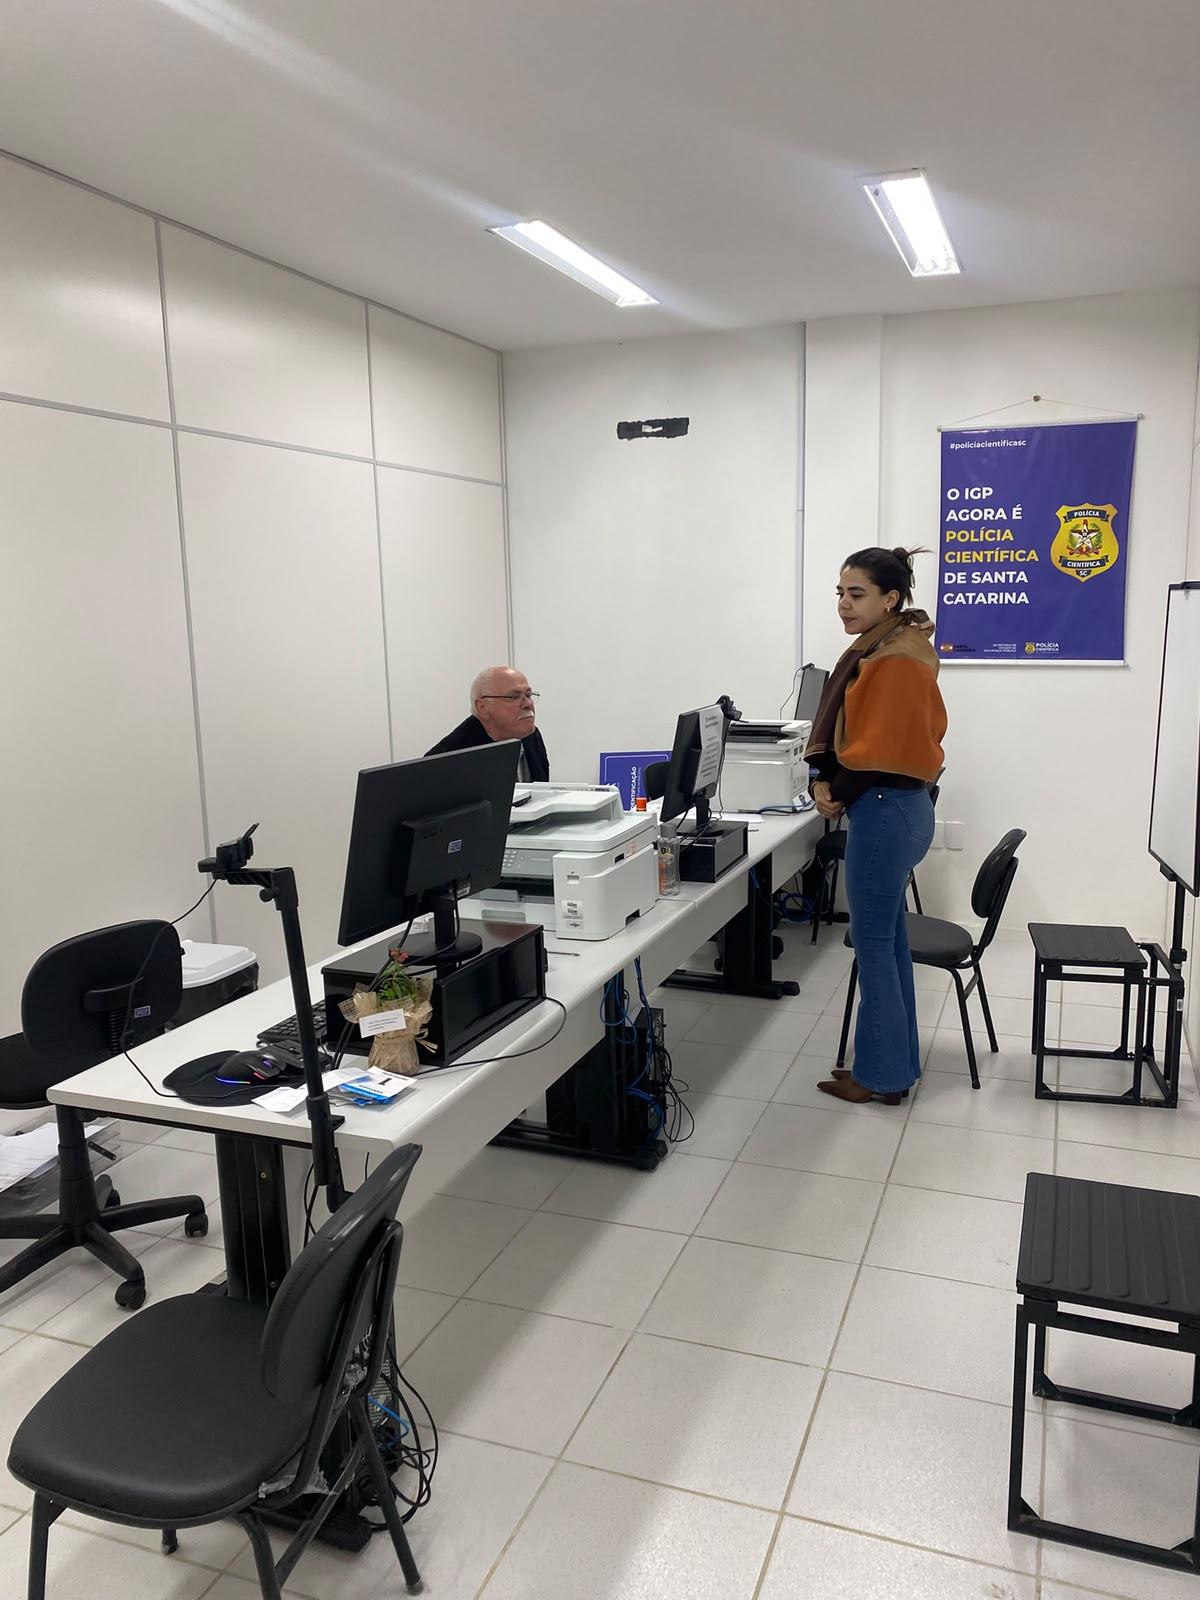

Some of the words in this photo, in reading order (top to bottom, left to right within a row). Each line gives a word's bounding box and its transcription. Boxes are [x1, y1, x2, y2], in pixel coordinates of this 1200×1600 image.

[946, 488, 960, 500] O
[964, 487, 994, 500] IGP
[945, 508, 1008, 522] AGORA
[1012, 504, 1023, 520] É
[1073, 509, 1100, 517] POLÍCIA
[945, 527, 1014, 542] POLÍCIA
[944, 547, 1039, 563] CIENTÍFICA
[944, 571, 967, 585] DE
[971, 570, 1029, 584] SANTA
[943, 591, 1030, 605] CATARINA
